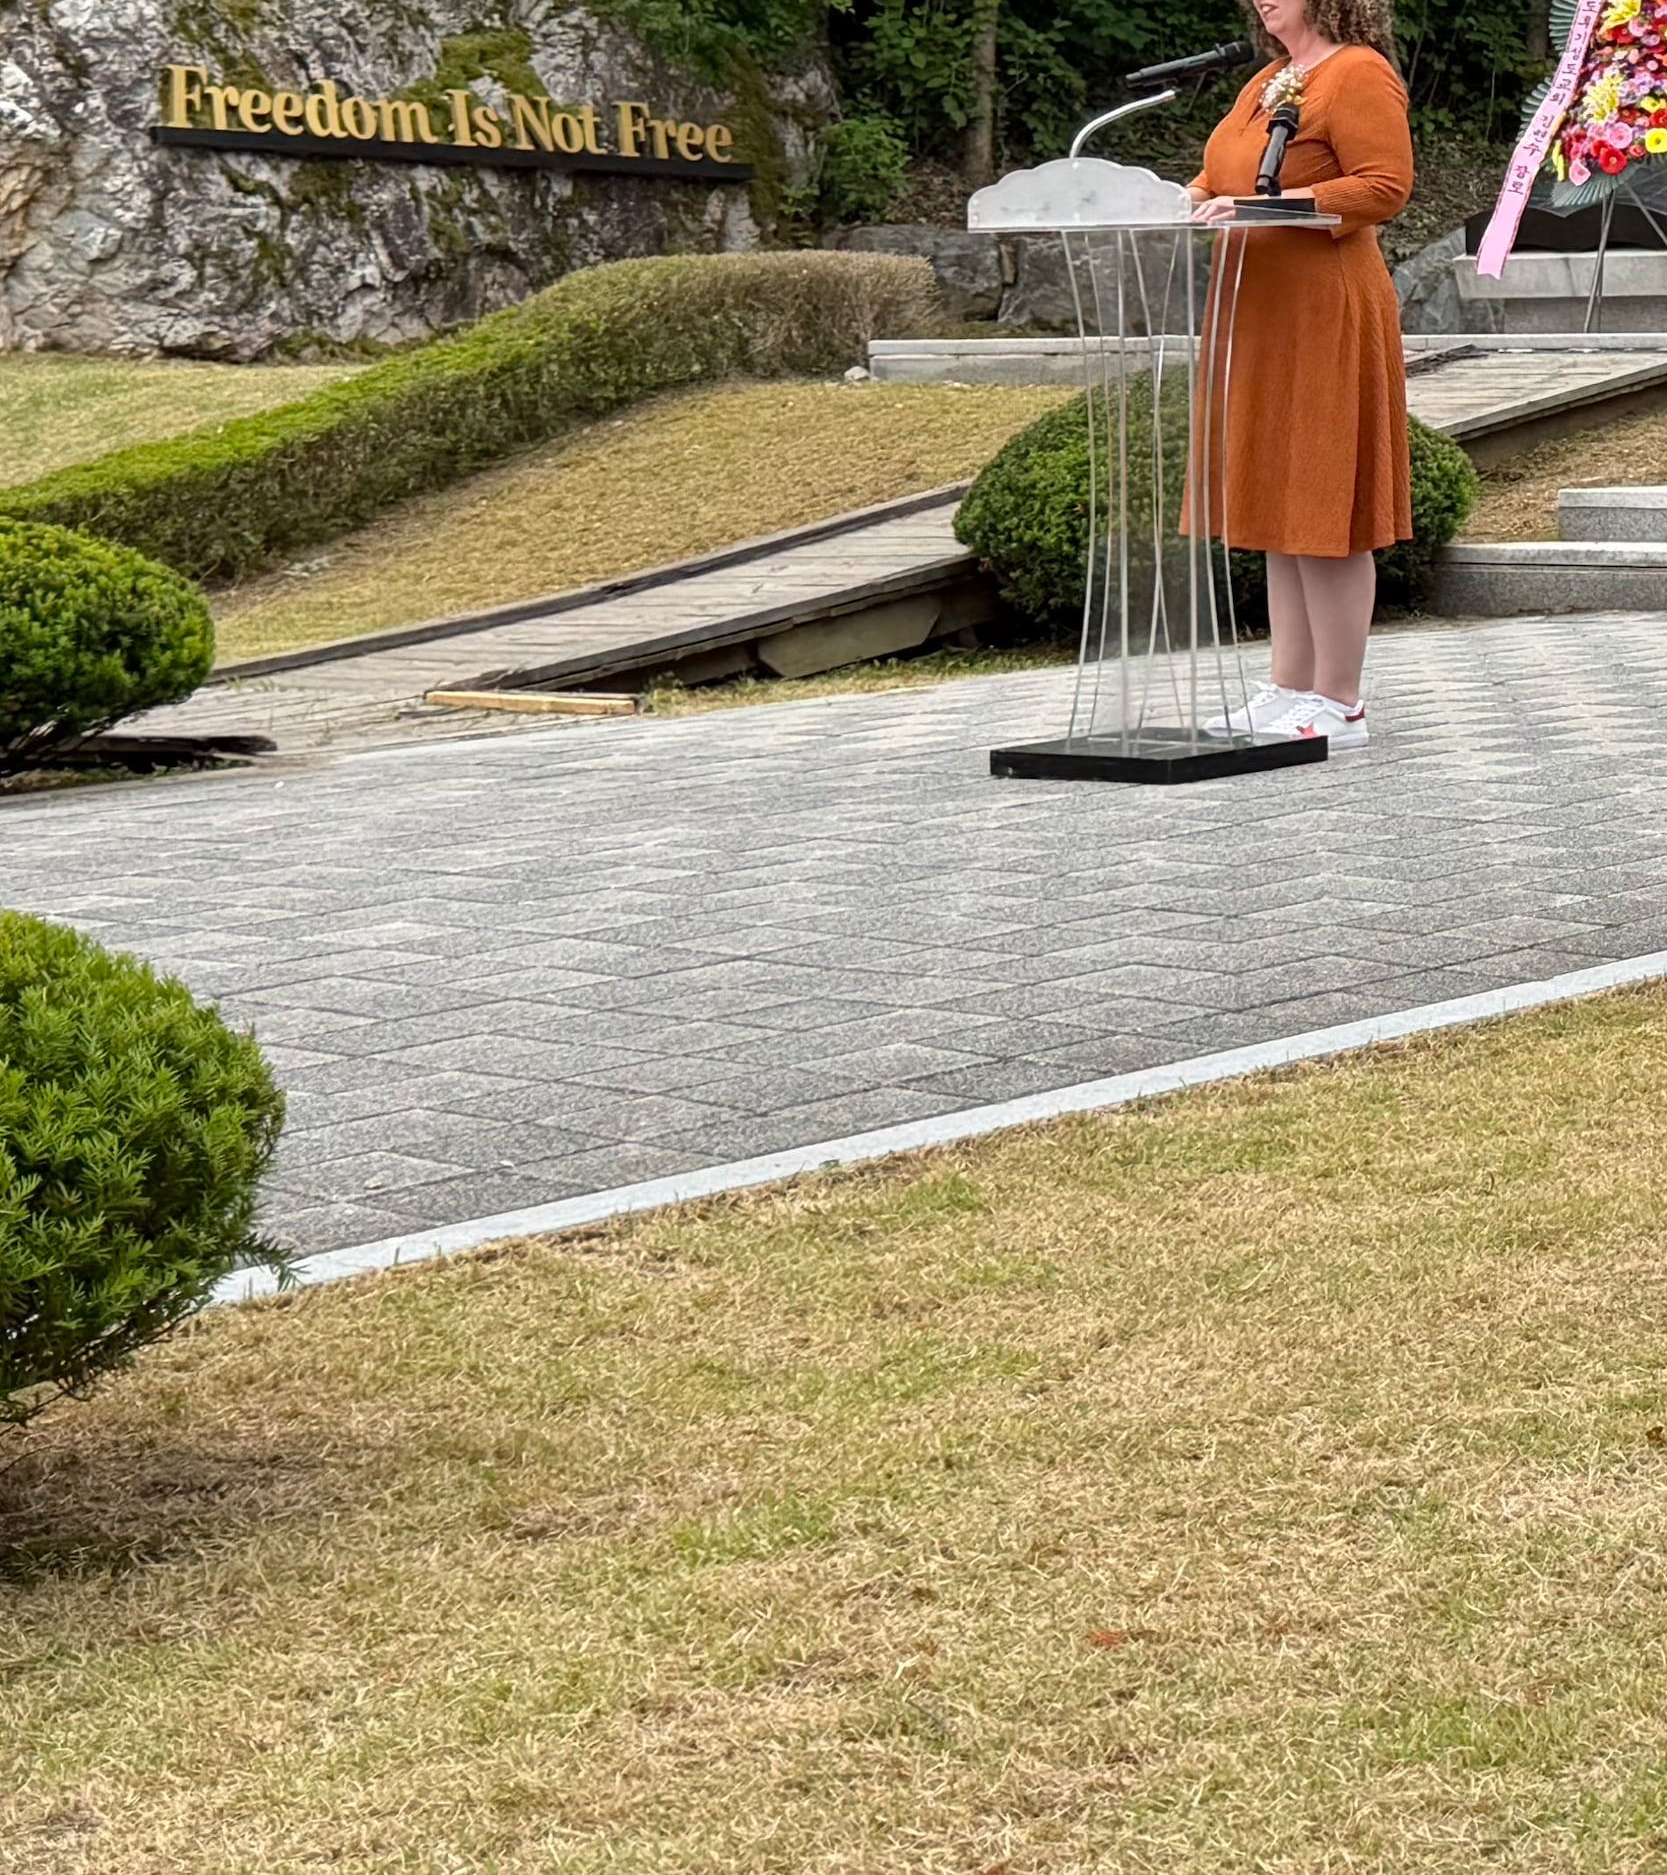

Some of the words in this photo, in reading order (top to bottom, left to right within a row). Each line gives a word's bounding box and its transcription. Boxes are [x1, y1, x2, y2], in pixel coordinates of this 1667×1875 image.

[165, 64, 432, 145] Freedom
[446, 88, 501, 148] Is
[508, 94, 604, 155] Not
[613, 100, 734, 163] Free
